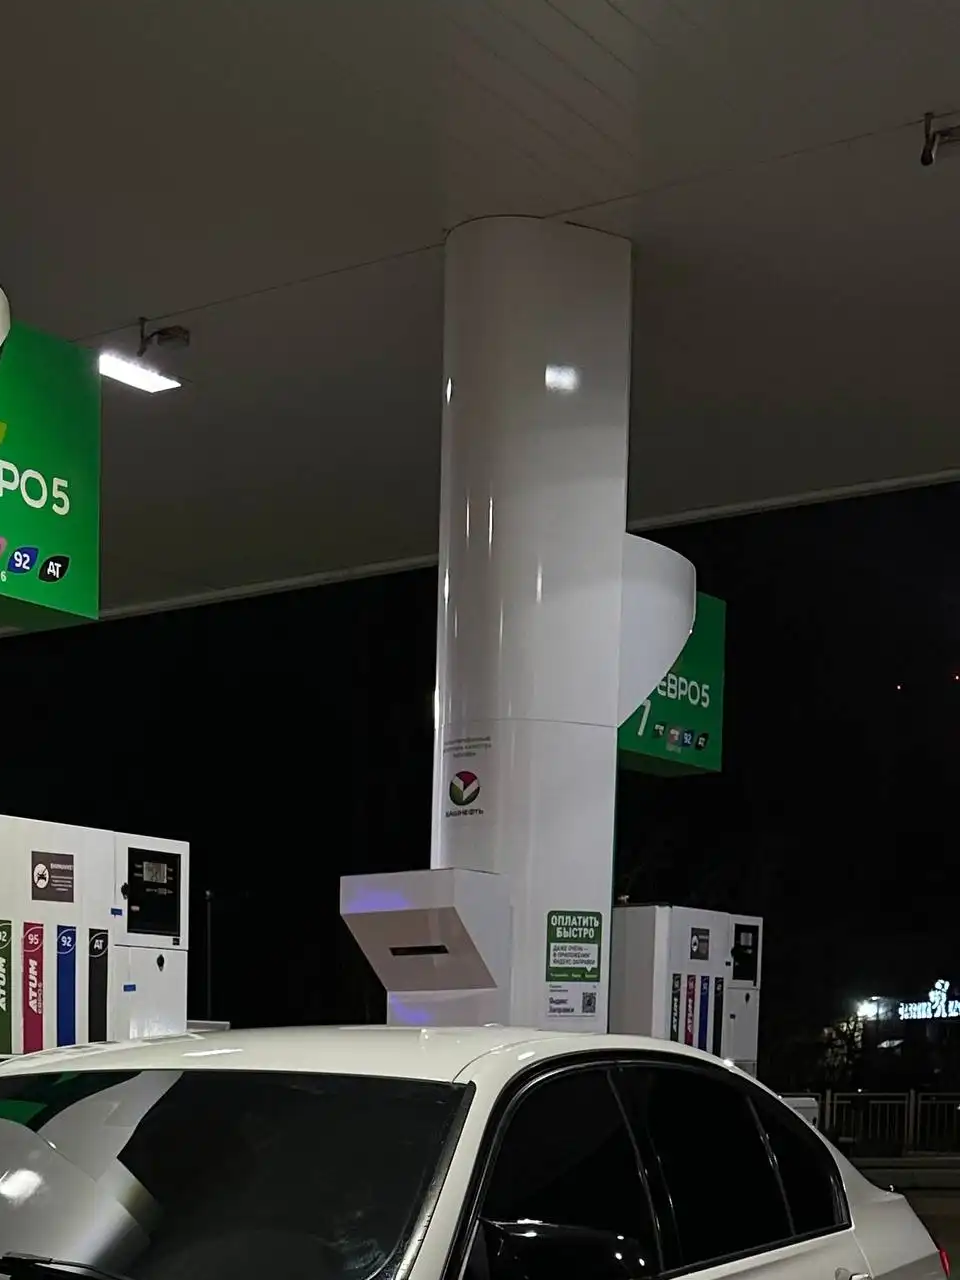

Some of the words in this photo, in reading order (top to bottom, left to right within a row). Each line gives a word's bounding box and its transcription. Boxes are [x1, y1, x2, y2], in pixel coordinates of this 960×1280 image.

[13, 551, 31, 570] 92
[551, 915, 600, 927] ОПЛАТИТЬ
[556, 927, 594, 938] БЫСТРО
[27, 933, 40, 945] 95
[61, 935, 73, 947] 92
[28, 958, 38, 1014] ATUM
